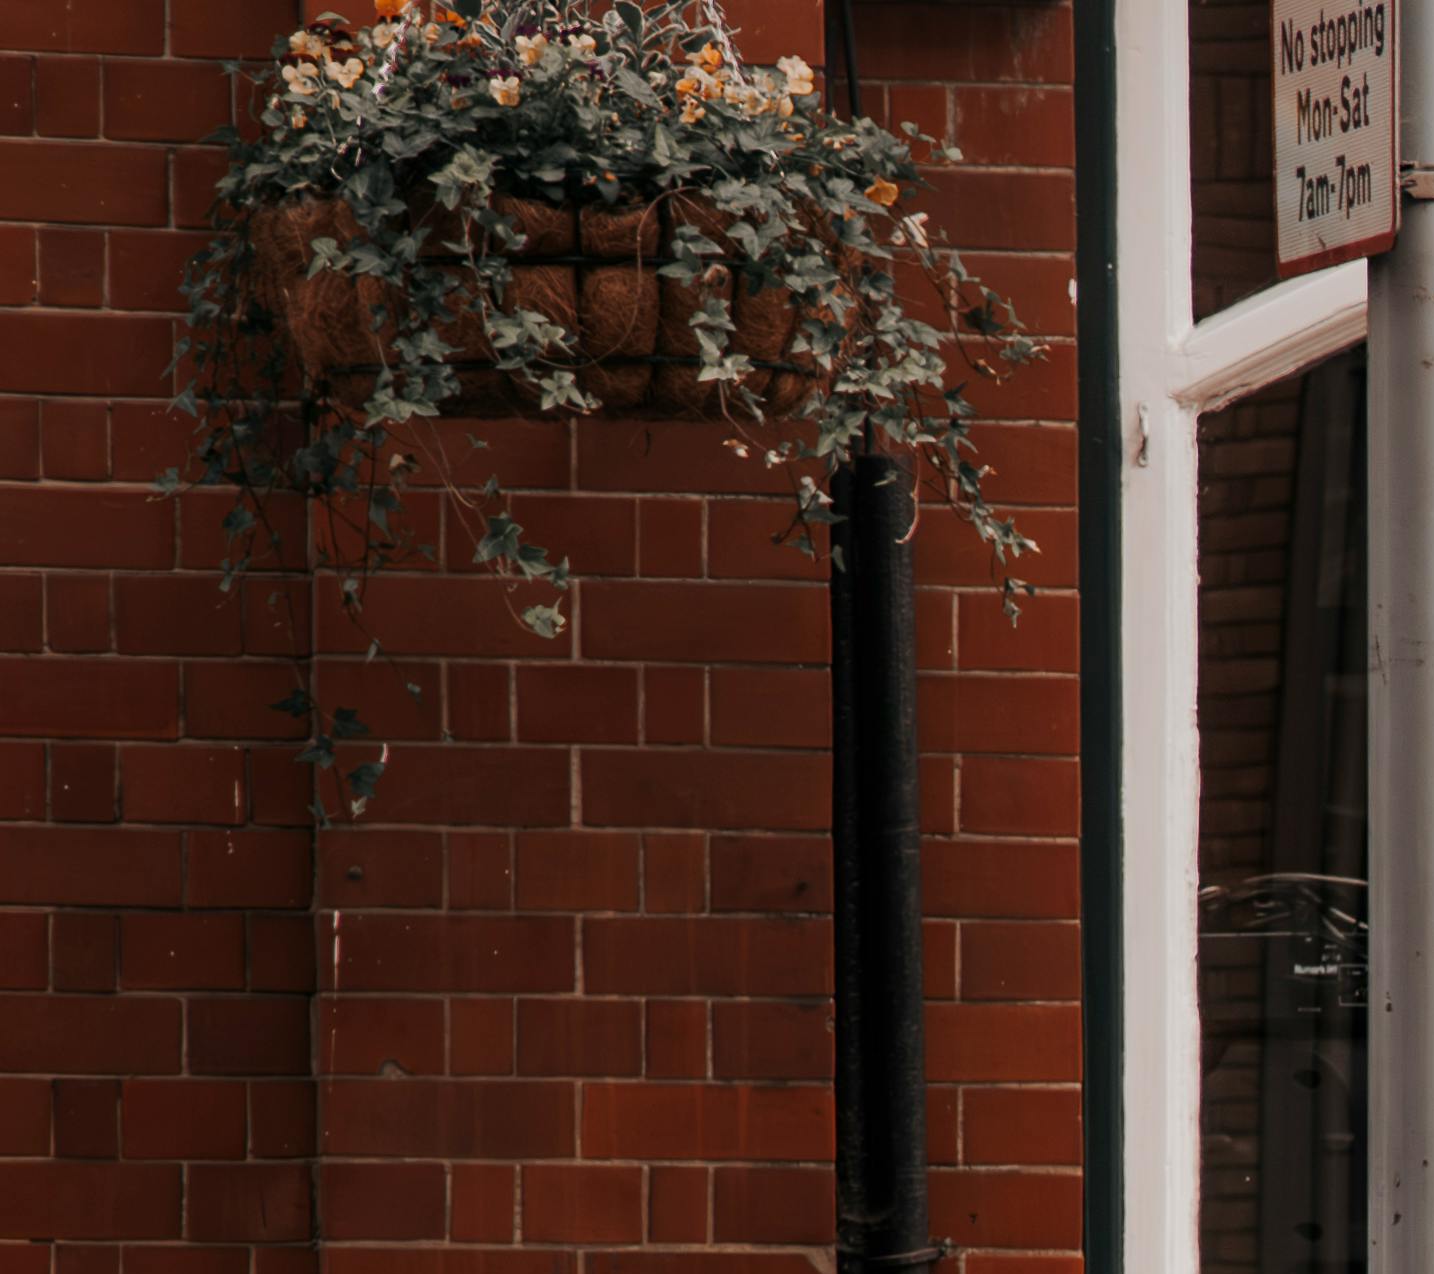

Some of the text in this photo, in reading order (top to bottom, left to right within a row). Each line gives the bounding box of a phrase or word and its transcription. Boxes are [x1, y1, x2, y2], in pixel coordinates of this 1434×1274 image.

[1281, 0, 1385, 75] No stopping
[1297, 72, 1370, 145] Mon-Sat
[1296, 154, 1372, 221] 7am-7pm
